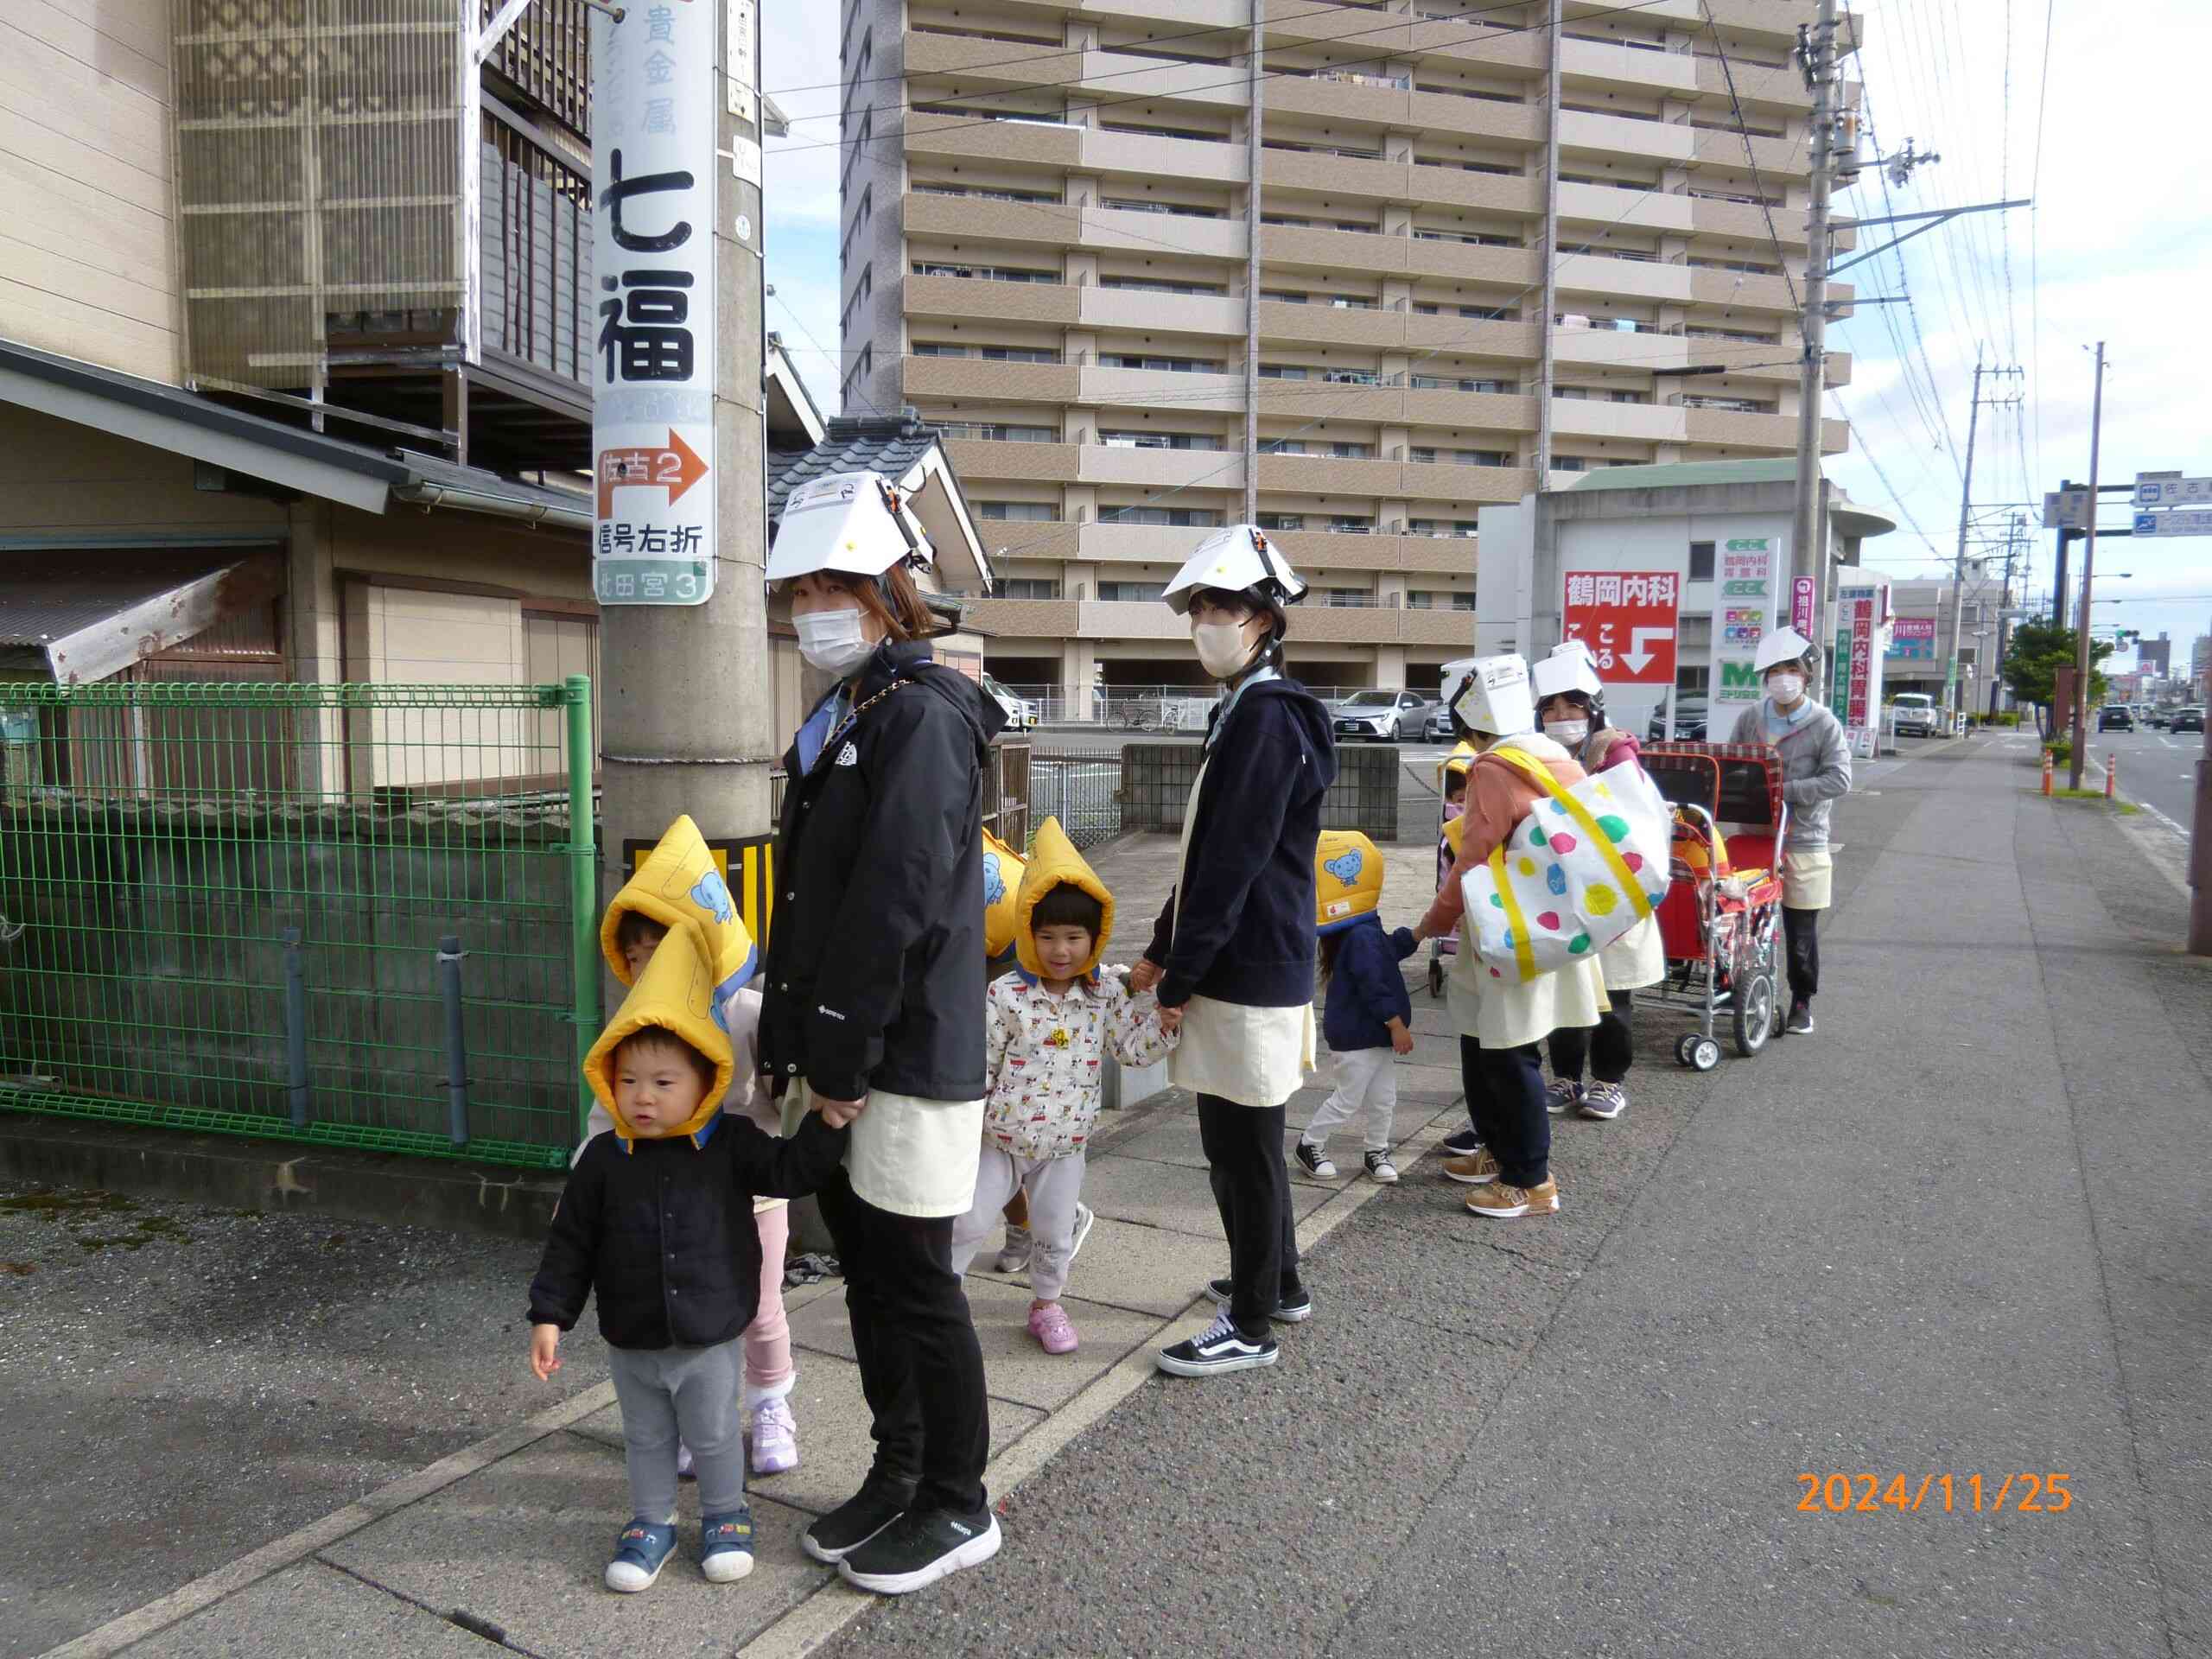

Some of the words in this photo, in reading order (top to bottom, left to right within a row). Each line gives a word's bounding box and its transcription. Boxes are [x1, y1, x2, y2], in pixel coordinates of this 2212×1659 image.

[642, 4, 677, 136] 貴金属
[598, 149, 695, 385] 七福
[599, 524, 704, 554] 信号右折
[1567, 575, 1675, 607] 鶴岡内科
